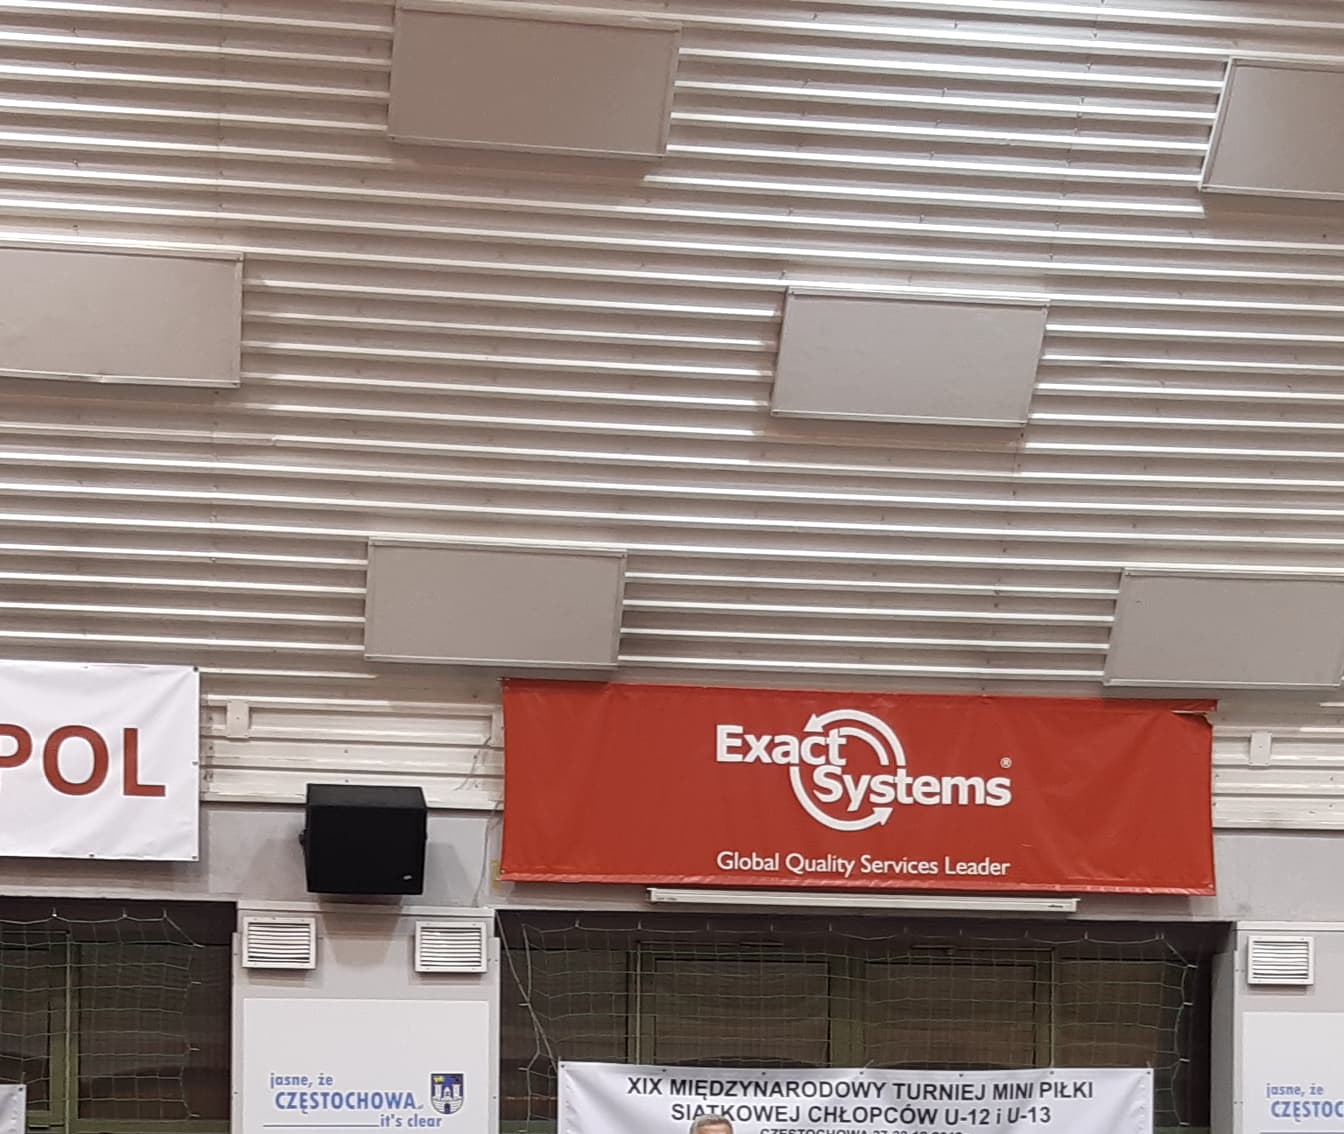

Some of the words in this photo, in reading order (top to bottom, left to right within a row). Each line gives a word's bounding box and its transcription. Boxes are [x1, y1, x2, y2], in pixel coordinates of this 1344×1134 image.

[716, 725, 847, 766] Exact
[812, 764, 1013, 812] Systems
[716, 851, 779, 871] Global
[785, 853, 856, 878] Quality
[860, 855, 938, 875] Services
[944, 856, 1011, 876] Leader
[269, 1072, 314, 1090] jasne,
[317, 1072, 334, 1087] że
[626, 1076, 663, 1098] XIX
[669, 1077, 886, 1100] MIĘDZYNARODOWY
[892, 1081, 986, 1102] TURNIEJ
[992, 1081, 1034, 1101] MINI
[1039, 1080, 1094, 1101] PIŁKI
[1265, 1083, 1306, 1098] jasne,
[1309, 1083, 1324, 1096] że
[274, 1091, 416, 1115] CZĘSTOCHOWA
[671, 1102, 802, 1123] SIATKOWEJ
[808, 1100, 938, 1126] CHŁOPCÓW
[944, 1105, 991, 1126] U-12
[995, 1104, 1003, 1125] i
[1006, 1103, 1052, 1124] U-13
[379, 1113, 403, 1128] it's
[407, 1113, 443, 1128] clear
